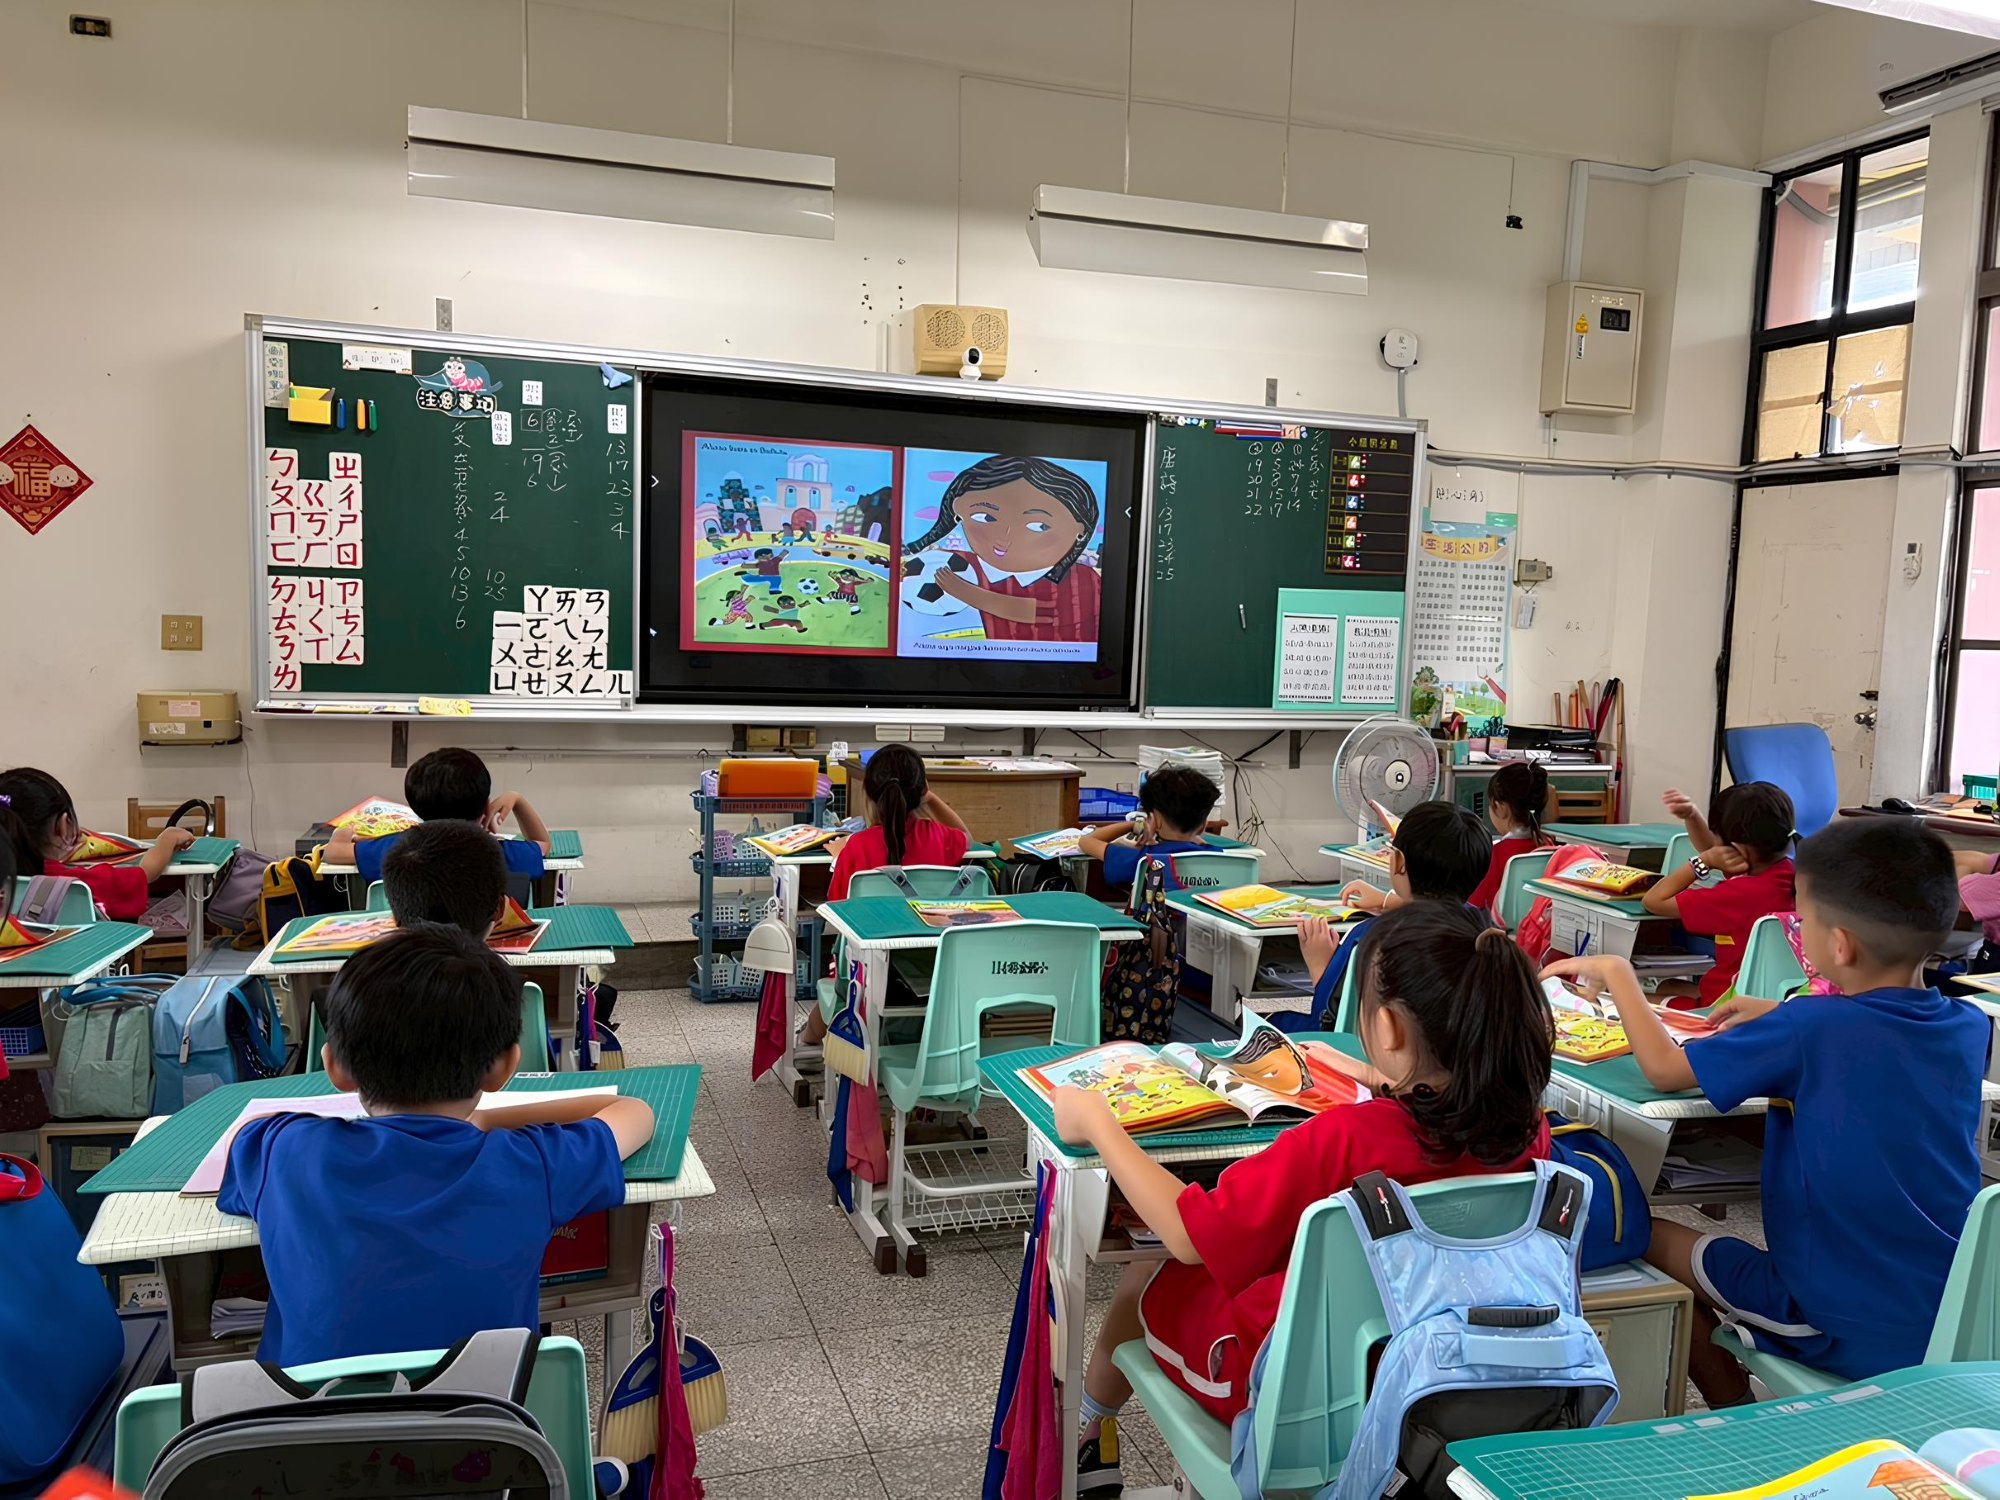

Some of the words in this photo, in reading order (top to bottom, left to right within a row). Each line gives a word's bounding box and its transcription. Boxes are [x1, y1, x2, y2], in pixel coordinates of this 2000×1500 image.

[609, 461, 629, 475] 17
[13, 462, 51, 497] 福
[1248, 475, 1263, 485] 20
[606, 480, 632, 497] 23
[494, 492, 507, 501] 2
[489, 506, 511, 523] 4
[609, 502, 624, 517] 3
[1158, 506, 1173, 522] 13
[1244, 504, 1263, 516] 22
[1269, 503, 1283, 518] 17
[454, 528, 469, 541] 4
[611, 522, 632, 540] 4
[1158, 523, 1172, 535] 17
[457, 546, 471, 561] 5
[450, 566, 471, 581] 10
[486, 568, 506, 584] 10
[451, 584, 469, 602] 13
[484, 586, 508, 601] 25
[455, 605, 466, 630] 6
